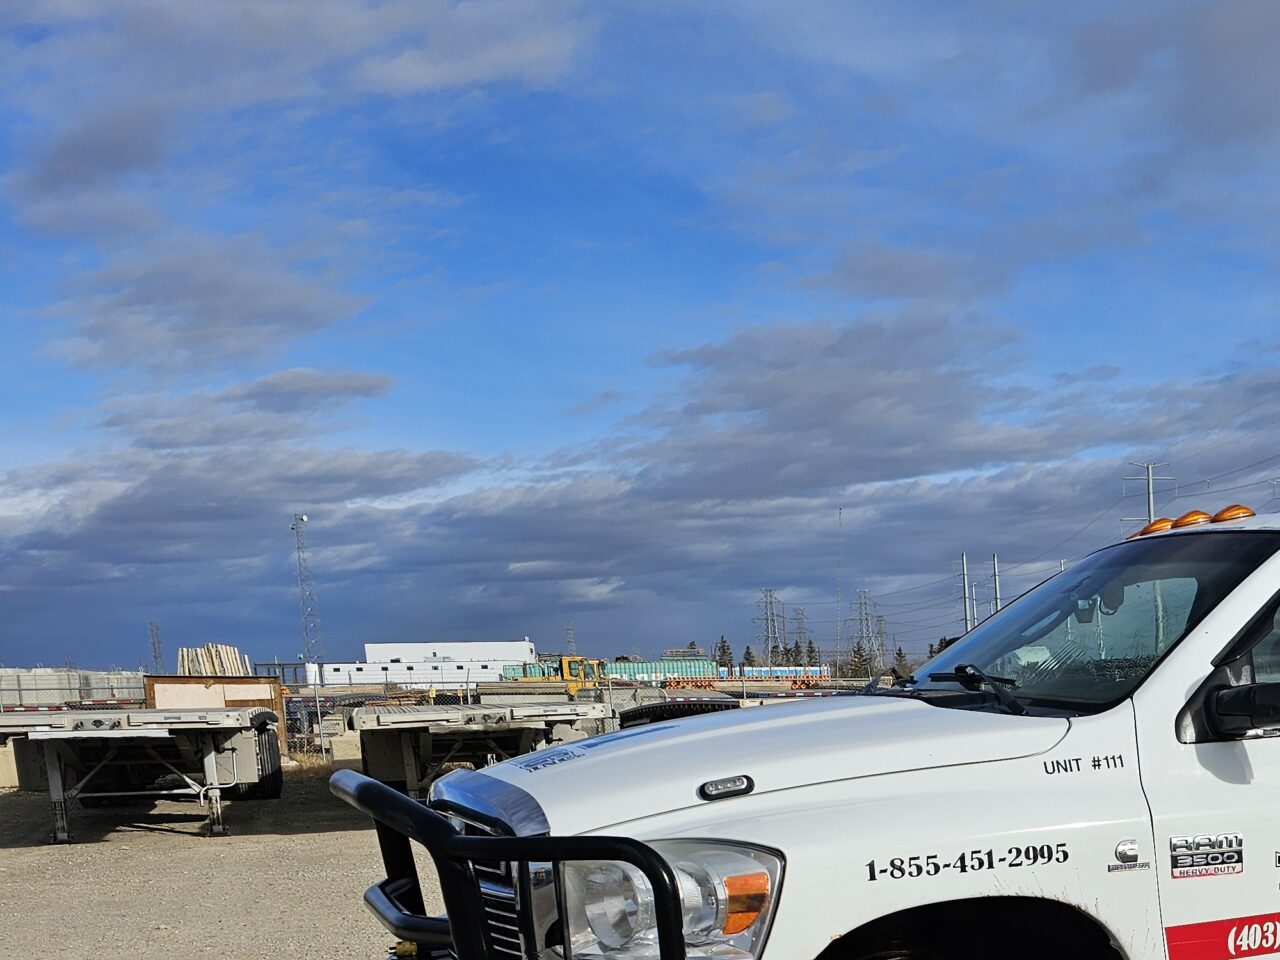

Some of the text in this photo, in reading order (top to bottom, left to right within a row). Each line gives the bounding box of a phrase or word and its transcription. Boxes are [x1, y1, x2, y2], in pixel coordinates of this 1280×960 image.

[1043, 754, 1125, 775] UNIT #111
[1170, 832, 1243, 855] RAM
[865, 843, 1070, 882] 1-855-451-2995
[1177, 852, 1238, 867] 3500
[1179, 865, 1237, 877] HEAVY DUTY
